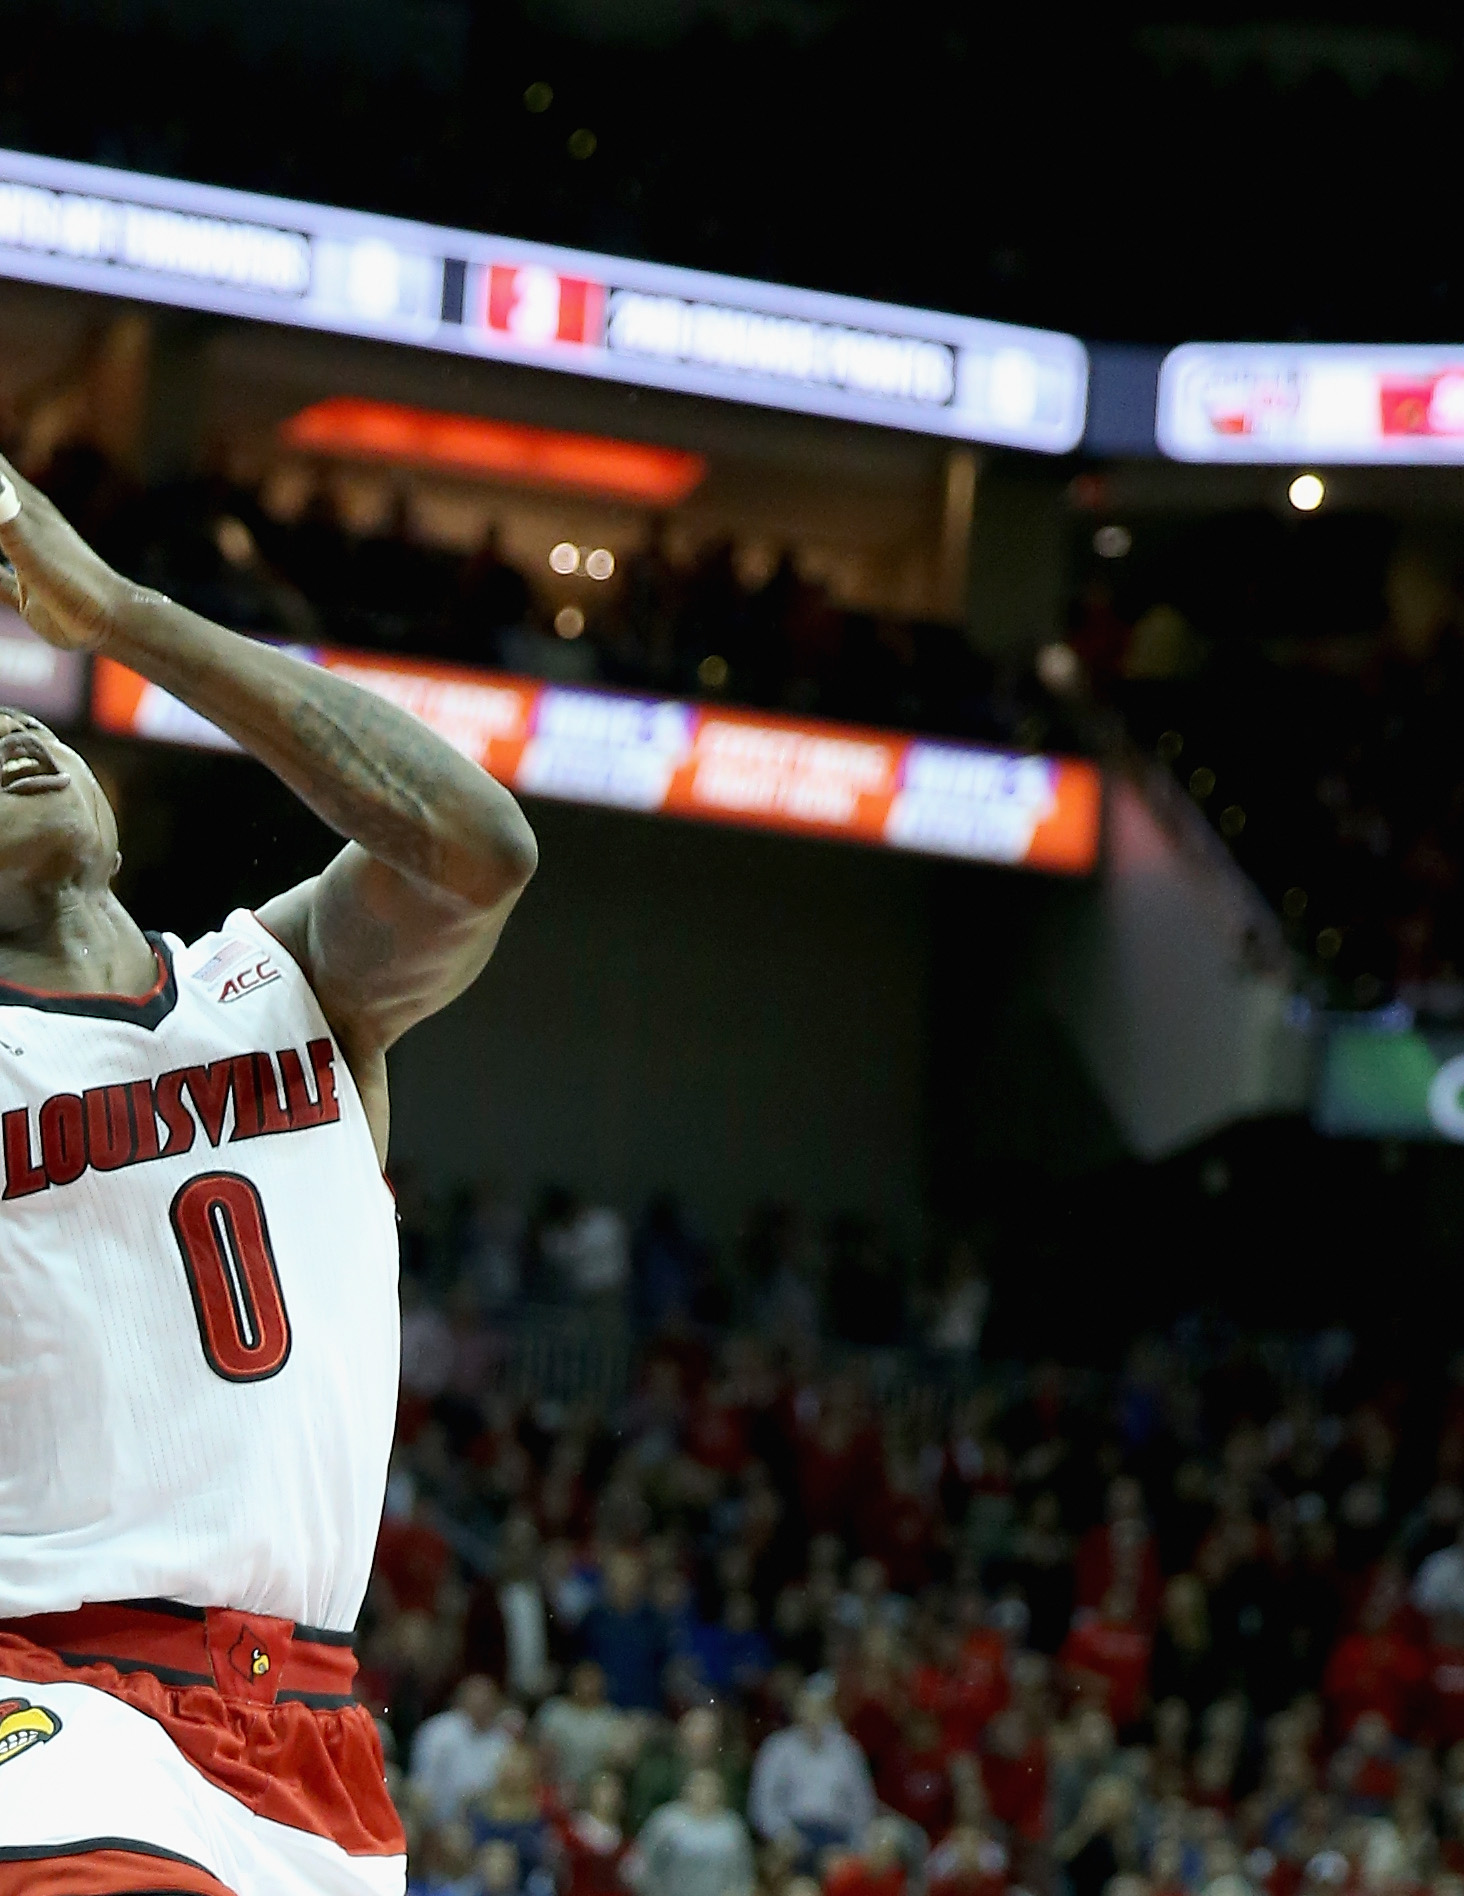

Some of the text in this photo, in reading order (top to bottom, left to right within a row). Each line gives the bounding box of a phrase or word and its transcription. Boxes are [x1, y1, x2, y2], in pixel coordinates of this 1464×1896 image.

[218, 955, 280, 1003] ACC
[1, 1038, 340, 1200] LOUISVILLE
[169, 1170, 292, 1382] 0
